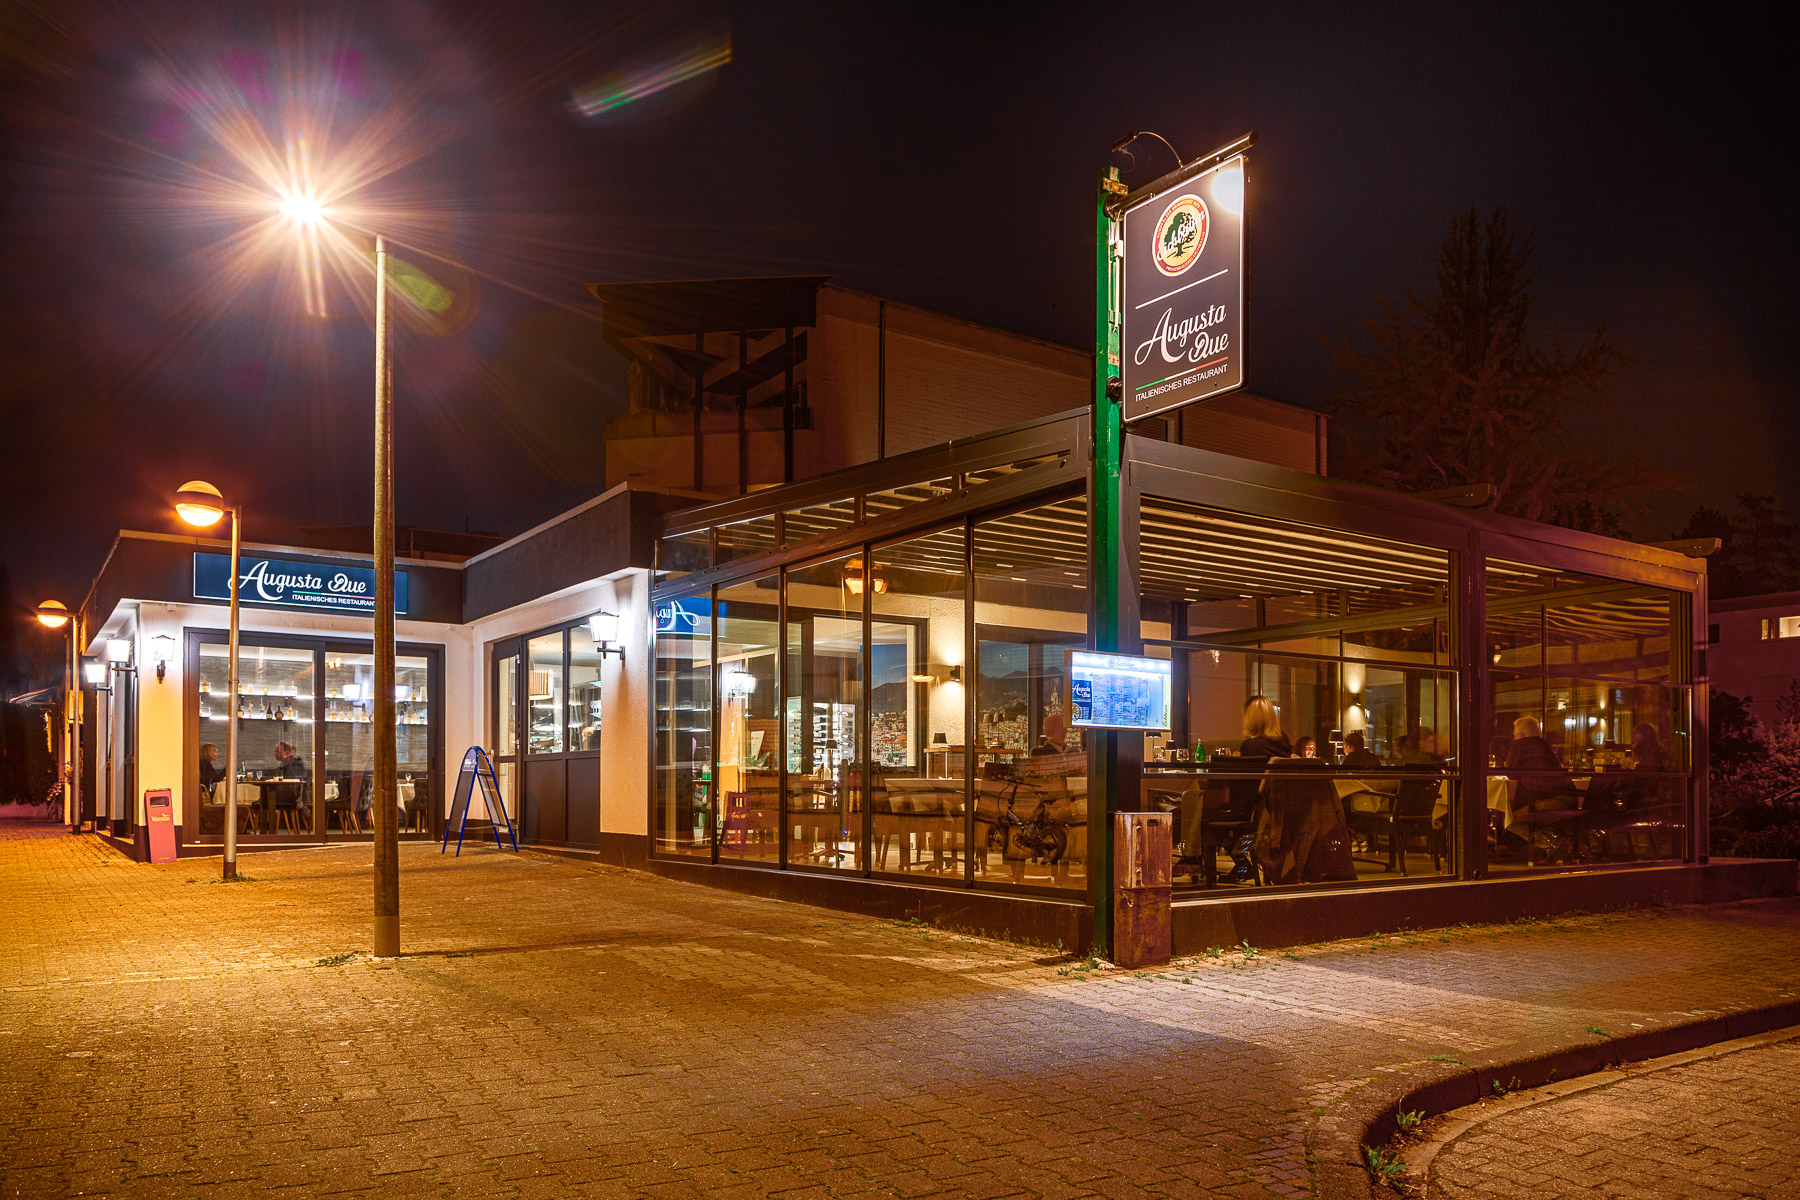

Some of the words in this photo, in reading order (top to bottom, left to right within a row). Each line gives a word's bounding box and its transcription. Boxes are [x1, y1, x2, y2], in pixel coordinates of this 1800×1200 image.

[1134, 304, 1227, 366] Augusta
[1188, 331, 1229, 363] Due
[1136, 379, 1182, 402] ITALIENISCHES
[1183, 363, 1228, 389] RESTAURANT
[227, 560, 323, 601] Augusta
[328, 573, 367, 594] Due
[292, 594, 338, 604] ITALIENISCHES
